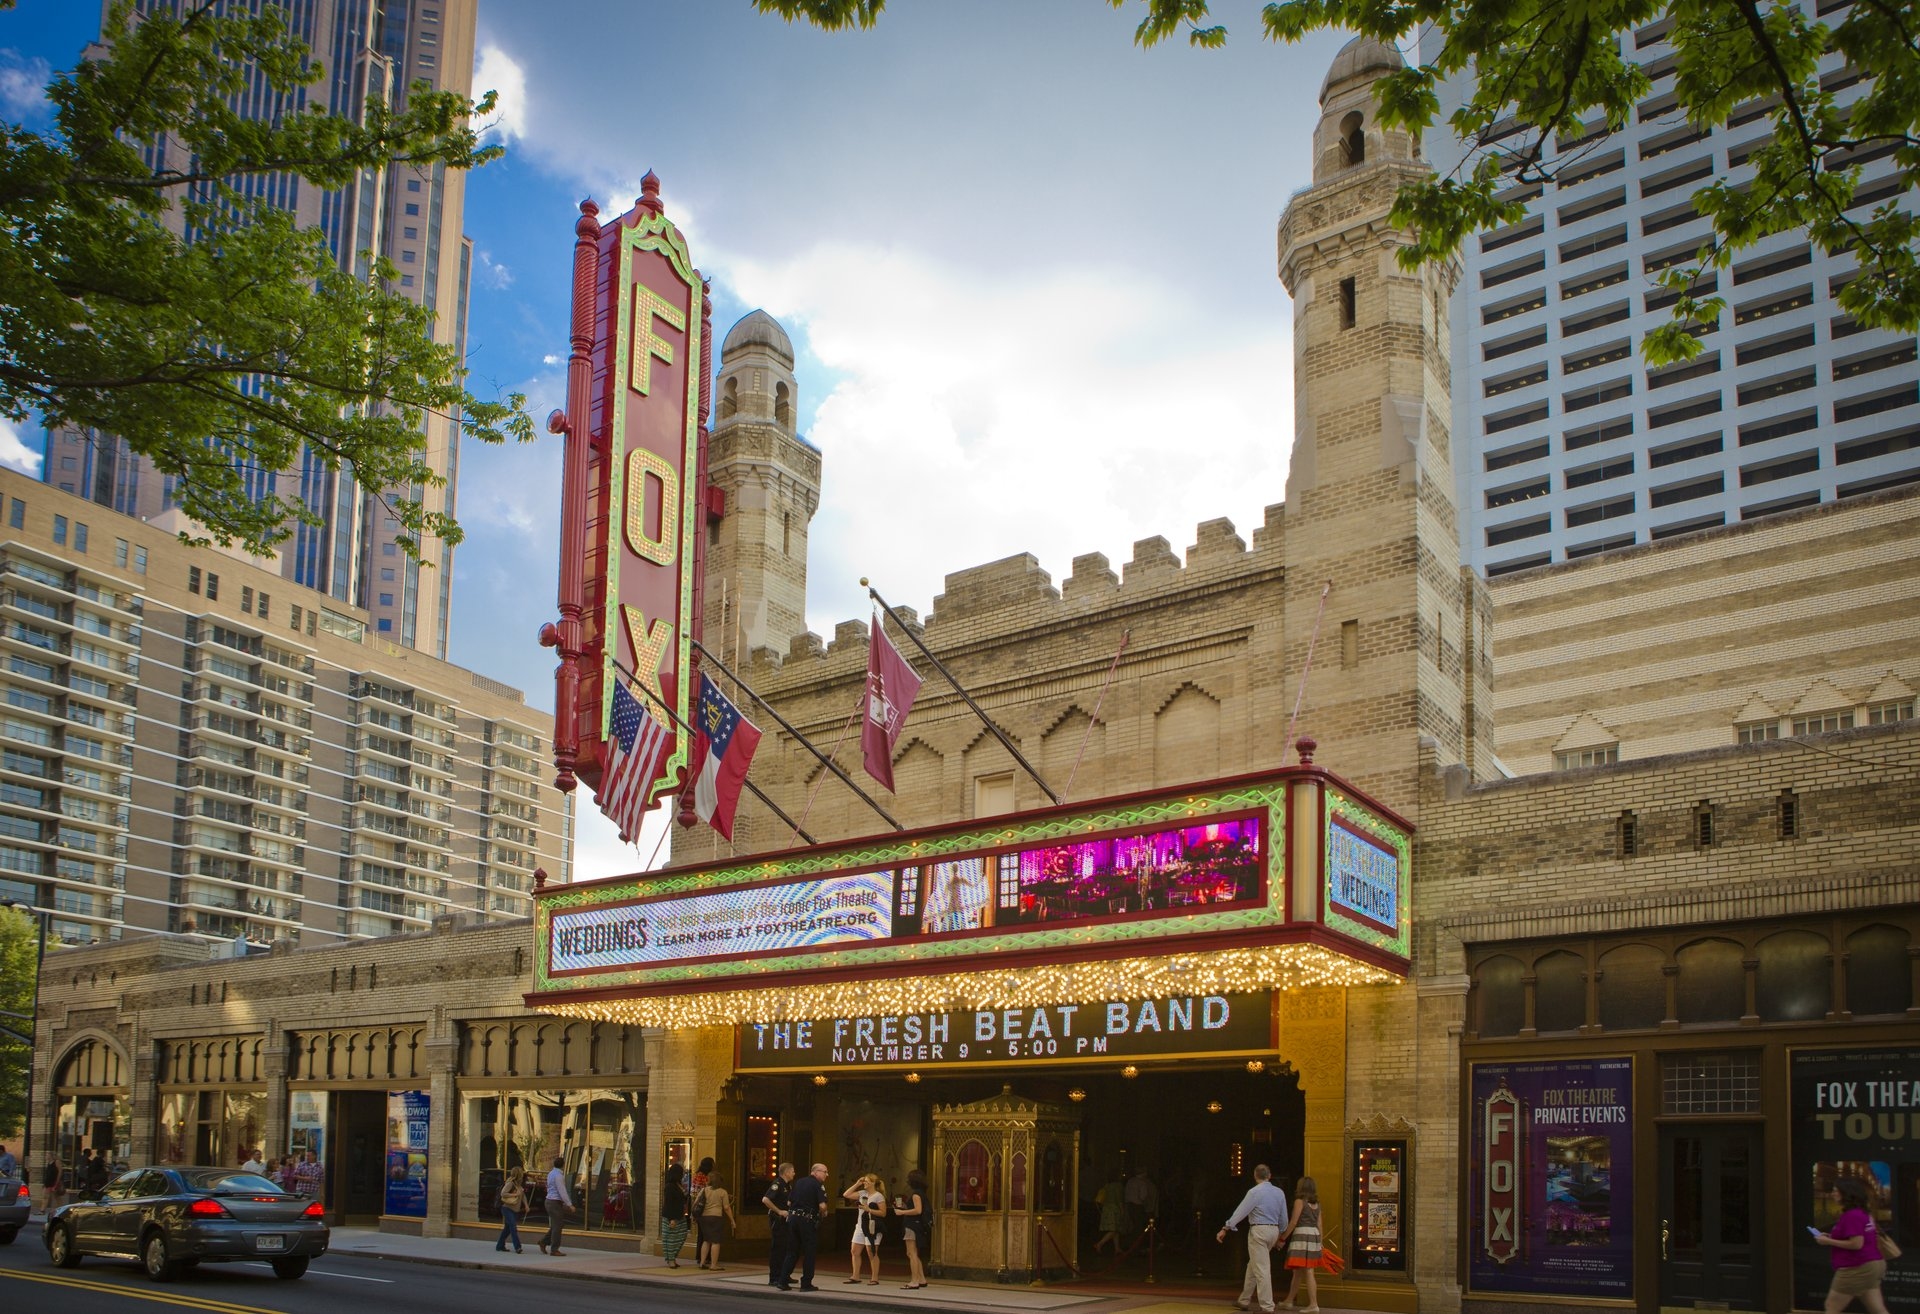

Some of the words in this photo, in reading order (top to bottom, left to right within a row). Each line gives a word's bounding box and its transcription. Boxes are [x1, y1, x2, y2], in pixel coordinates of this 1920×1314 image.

[624, 282, 685, 732] FOX
[814, 896, 832, 910] Fox
[835, 889, 878, 908] Theatre
[1340, 869, 1391, 919] WEDDINGS
[559, 918, 648, 958] WEDDINGS
[656, 933, 695, 947] LEARN
[698, 928, 733, 942] MORE
[736, 926, 752, 939] AT
[756, 911, 878, 937] FOXTHEATRE.ORG
[753, 1021, 813, 1050] THE
[834, 1013, 949, 1047] FRESH
[975, 1005, 1079, 1041] BEAT
[1106, 996, 1230, 1034] BAND
[832, 1044, 944, 1063] NOVEMBER
[958, 1043, 969, 1058] 9
[1008, 1039, 1057, 1056] 5:00
[1076, 1036, 1107, 1053] PM
[1543, 1089, 1565, 1107] FOX
[1567, 1087, 1617, 1105] THEATRE
[1816, 1082, 1858, 1108] FOX
[1865, 1080, 1920, 1107] THEA
[410, 1123, 427, 1132] BLUE
[1534, 1107, 1580, 1124] PRIVATE
[1582, 1106, 1626, 1123] EVENTS
[410, 1131, 427, 1141] MAN
[1491, 1112, 1513, 1241] FOX
